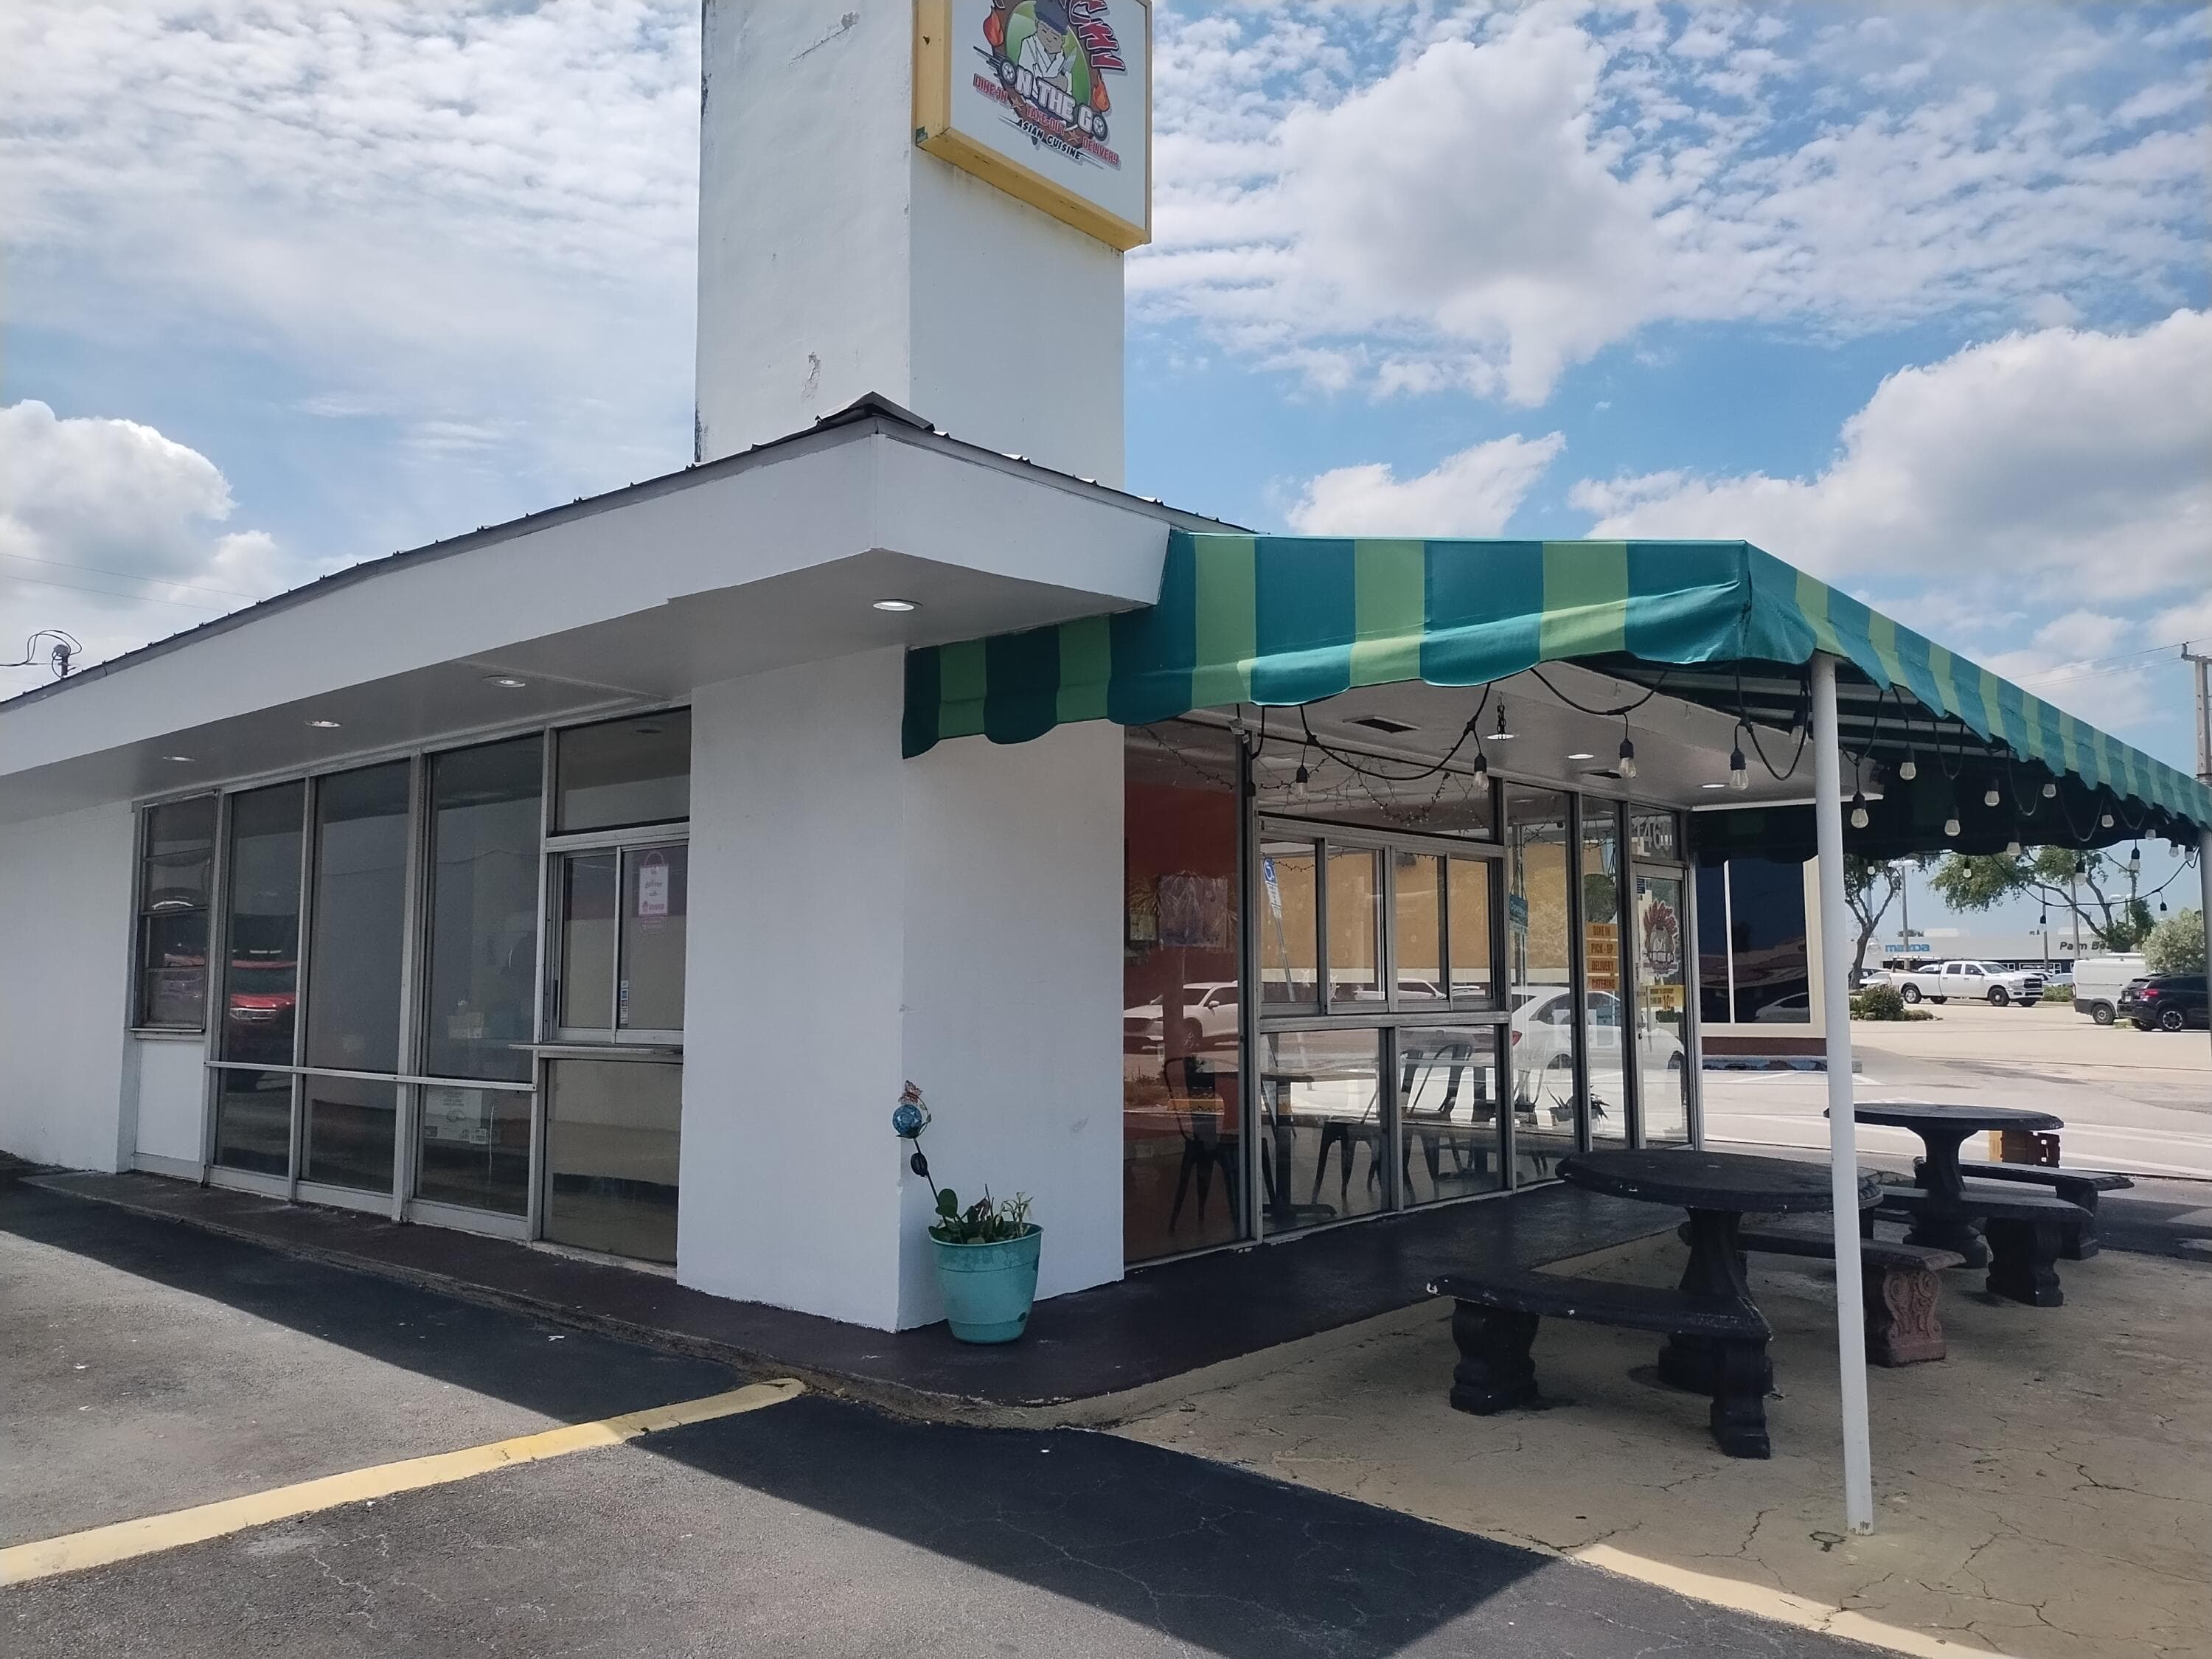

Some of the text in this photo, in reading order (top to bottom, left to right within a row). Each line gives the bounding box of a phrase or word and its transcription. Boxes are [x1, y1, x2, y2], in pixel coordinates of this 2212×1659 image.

[974, 74, 1009, 102] DINE-IN
[1035, 76, 1077, 125] THE
[1026, 104, 1067, 136] TAKE-OUT
[1017, 119, 1082, 160] ASIAN CUISINE
[1082, 136, 1119, 165] DELIVERY
[1593, 925, 1610, 936] DINE IN
[2059, 942, 2087, 950] Pam
[1592, 960, 1614, 971] DELIVERY
[1592, 978, 1615, 990] CATERING
